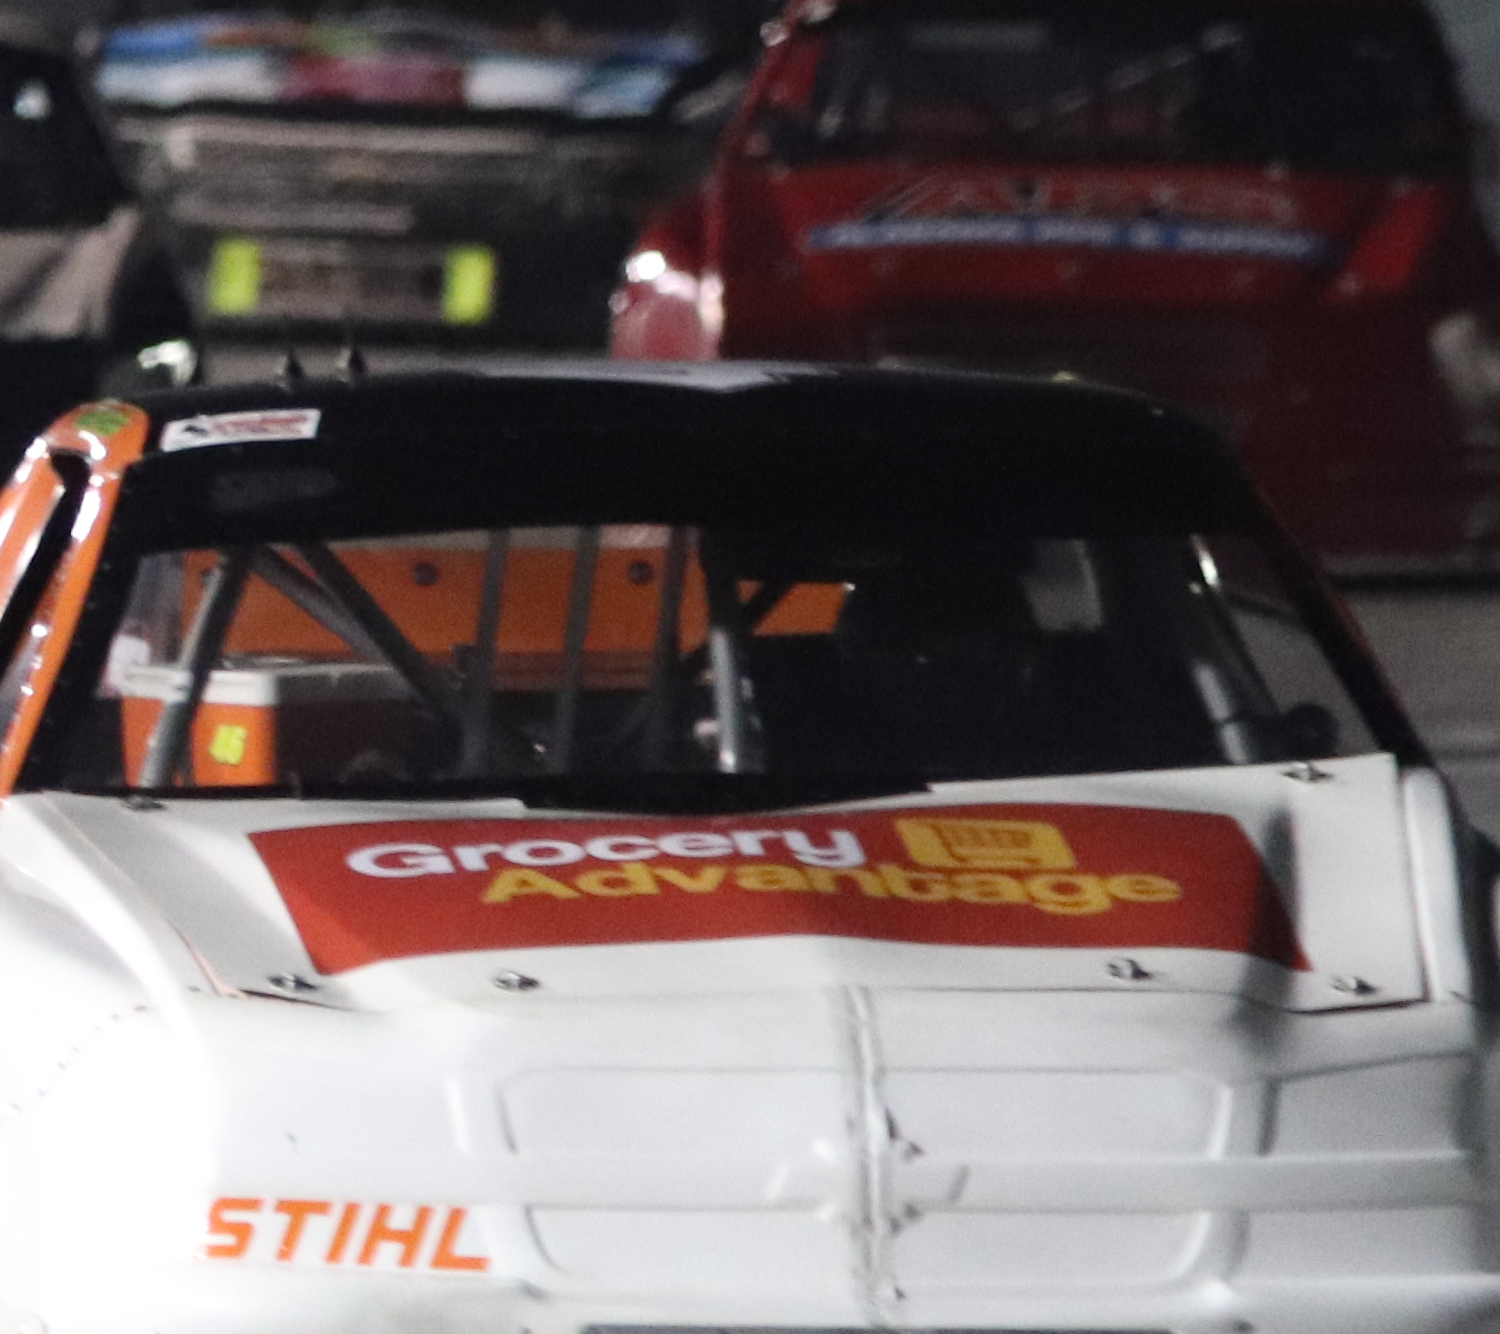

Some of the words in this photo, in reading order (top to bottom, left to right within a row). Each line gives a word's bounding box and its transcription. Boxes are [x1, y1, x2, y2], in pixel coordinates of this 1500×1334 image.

[346, 827, 866, 878] Grocery
[482, 859, 1184, 915] Advantage
[206, 1197, 491, 1273] STIHL
